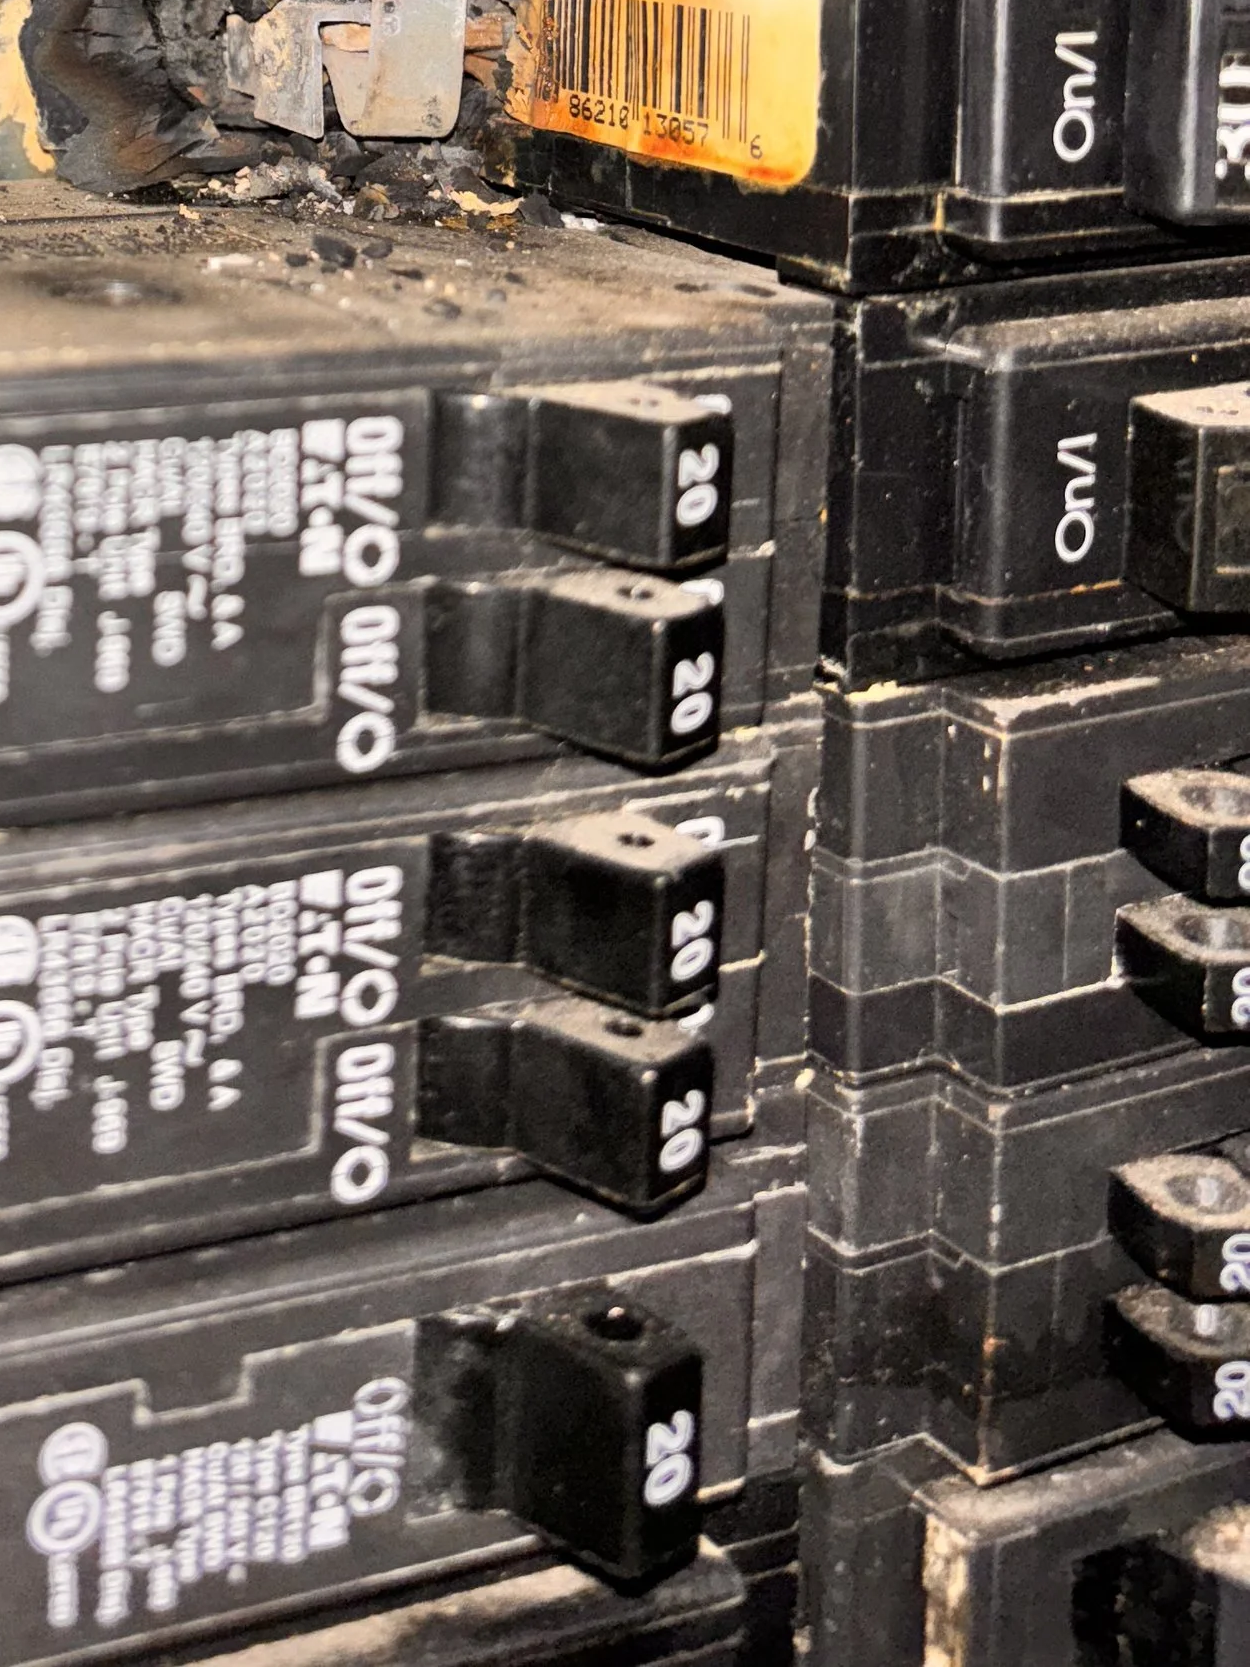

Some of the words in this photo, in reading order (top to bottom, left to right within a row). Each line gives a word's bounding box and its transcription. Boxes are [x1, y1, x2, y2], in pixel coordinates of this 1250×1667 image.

[568, 94, 630, 130] 86210
[642, 111, 710, 148] 13057
[749, 134, 764, 161] 6
[1052, 31, 1098, 163] On/I
[341, 416, 404, 586] Off/O
[676, 443, 720, 527] 20
[1054, 433, 1098, 563] On/I
[151, 590, 187, 666] SWD
[211, 621, 244, 650] A
[336, 605, 401, 773] Off/O
[670, 651, 714, 735] 20
[96, 932, 127, 996] Pole
[180, 894, 212, 998] 120/240
[339, 865, 404, 1027] Off/O
[669, 900, 714, 981] 20
[94, 998, 127, 1061] Unit
[123, 985, 159, 1051] Type
[180, 999, 211, 1025] V
[148, 1039, 185, 1111] SWD
[208, 1086, 241, 1111] A
[330, 1043, 395, 1204] Off/O
[658, 1089, 704, 1172] 20
[1213, 1360, 1250, 1420] 20
[252, 1430, 284, 1496] Type
[282, 1423, 311, 1484] Type
[347, 1377, 411, 1518] Off/O
[642, 1410, 694, 1506] 20
